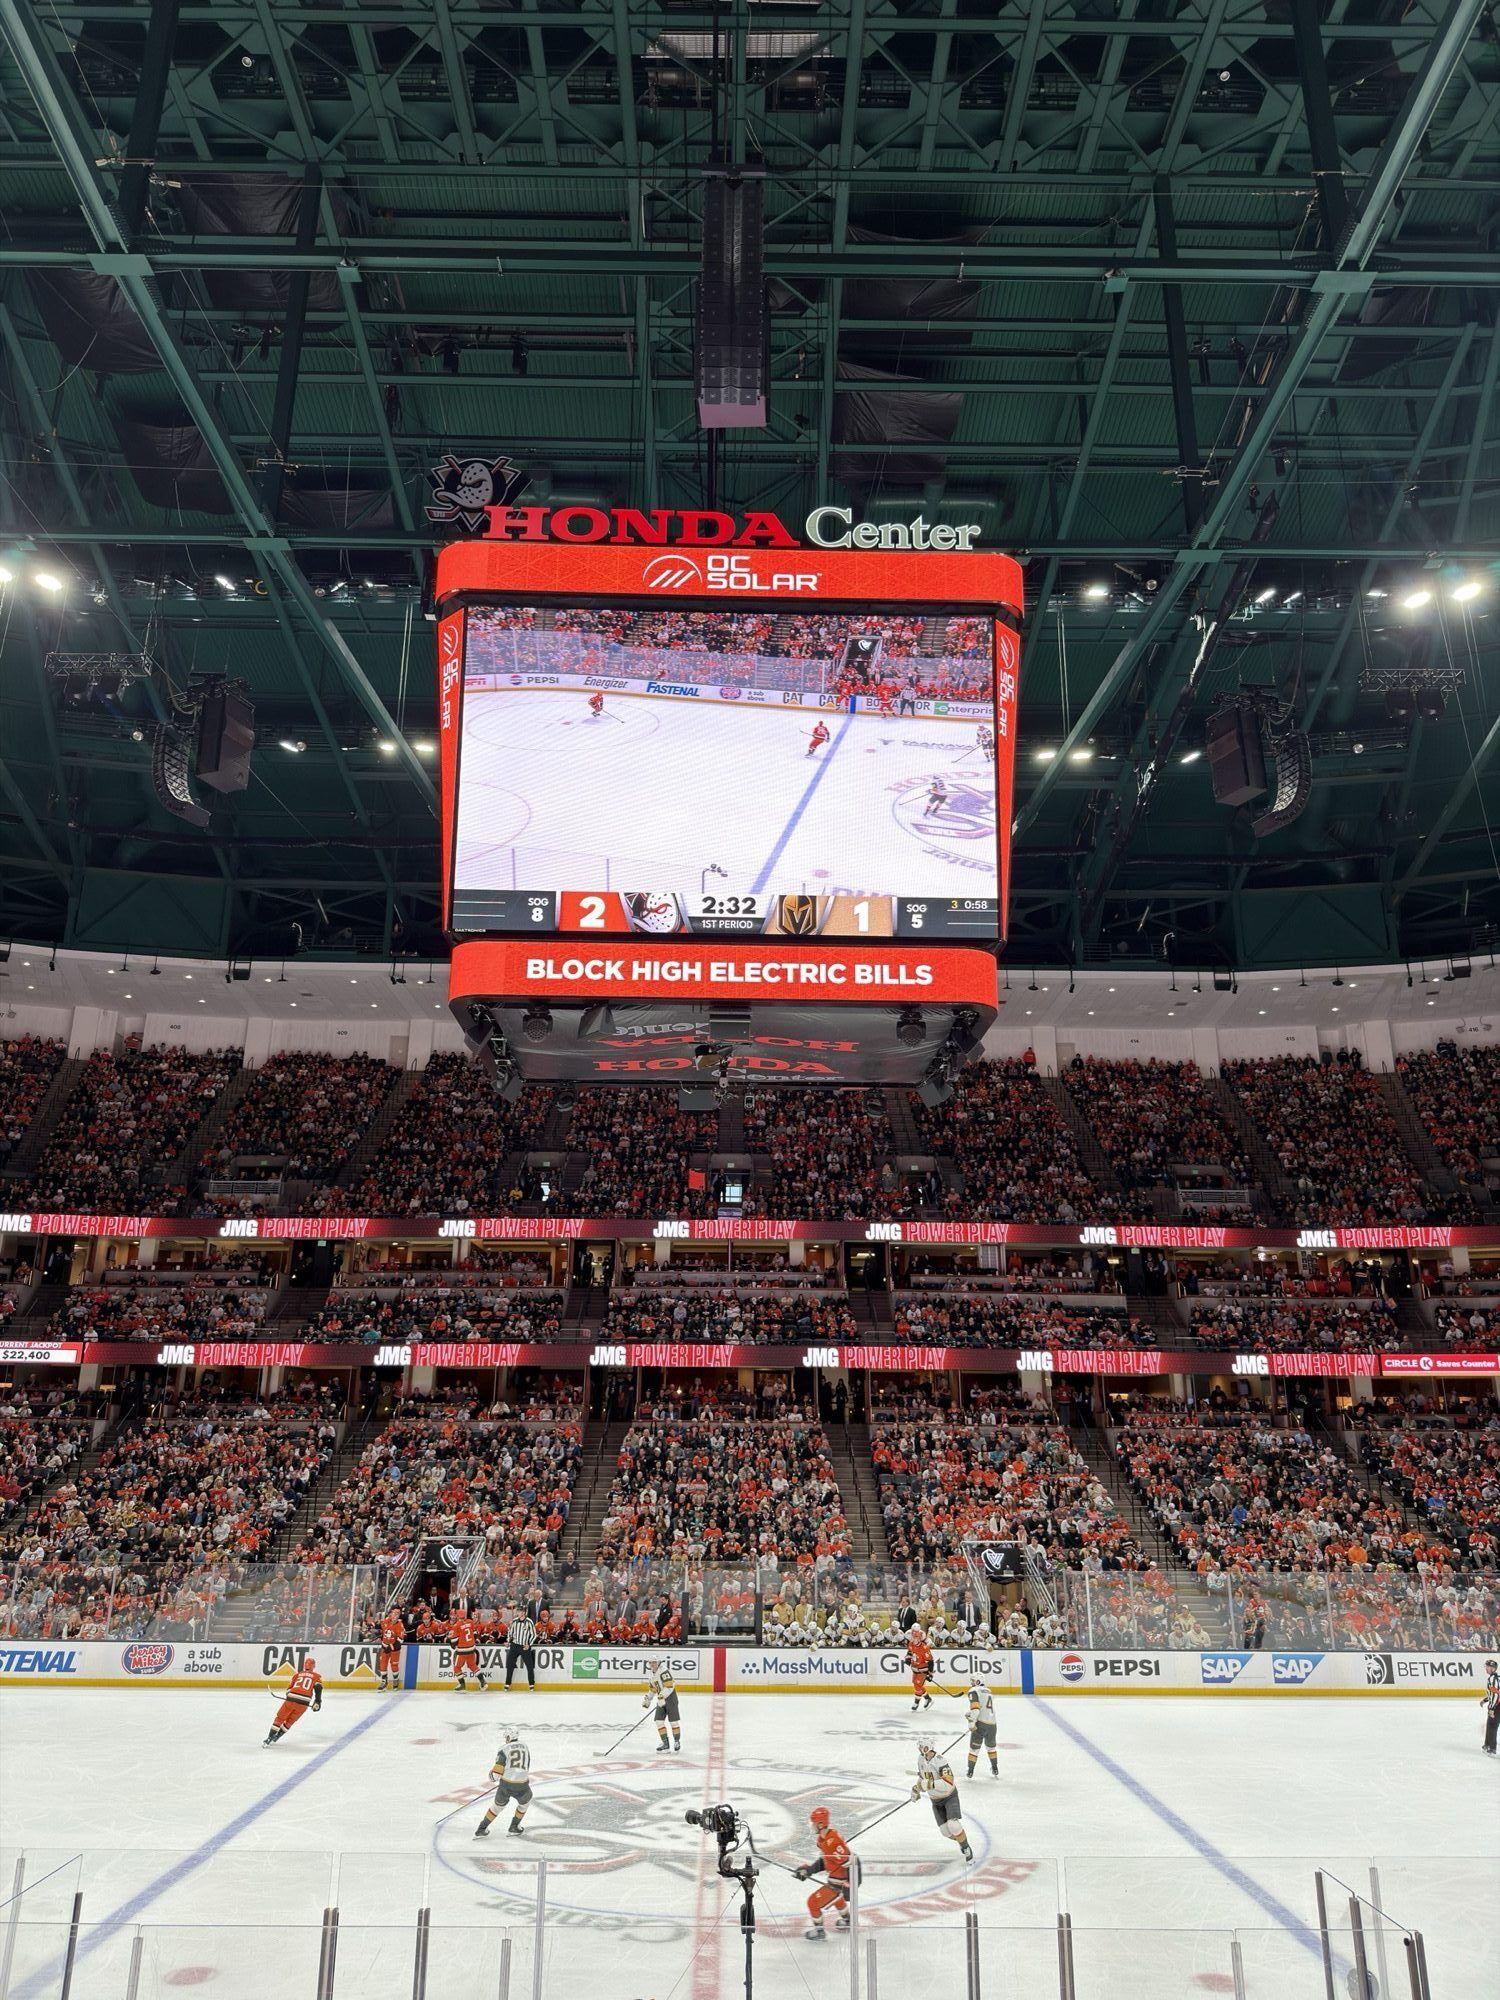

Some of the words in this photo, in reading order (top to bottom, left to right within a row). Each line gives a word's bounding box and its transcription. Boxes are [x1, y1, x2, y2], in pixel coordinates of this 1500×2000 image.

[482, 506, 800, 546] HONDA
[806, 506, 981, 551] Center
[527, 676, 559, 684] PEPSI
[583, 676, 629, 689] Energizer
[646, 681, 700, 697] FASTENAL
[783, 692, 803, 704] CAT
[528, 897, 548, 906] SOG
[702, 896, 757, 915] 2:32
[906, 903, 927, 913] SOG
[951, 901, 958, 909] 3
[964, 900, 988, 910] 0:58
[531, 907, 543, 922] 8
[579, 896, 605, 927] 2
[853, 902, 870, 932] 1
[911, 914, 923, 928] 5
[701, 919, 720, 928] 1ST
[722, 919, 753, 929] PERIOD
[526, 959, 624, 982] BLOCK
[632, 961, 701, 982] HIGH
[710, 962, 847, 984] ELECTRIC
[854, 964, 933, 985] BILLS
[38, 1214, 100, 1235] POWER
[103, 1215, 150, 1237] PLAY
[220, 1219, 259, 1237] JMG
[263, 1218, 326, 1238] POWER
[325, 1218, 369, 1238] PLAY
[438, 1220, 476, 1238] JMG
[480, 1218, 538, 1238] POWER
[542, 1218, 584, 1238] PLAY
[653, 1221, 690, 1238] JMG
[694, 1219, 752, 1239] POWER
[755, 1220, 797, 1240] PLAY
[865, 1223, 904, 1240] JMG
[907, 1222, 964, 1242] POWER
[967, 1223, 1009, 1243] PLAY
[1079, 1227, 1116, 1244] JMG
[1121, 1226, 1178, 1246] POWER
[1183, 1227, 1226, 1247] PLAY
[1297, 1231, 1337, 1248] JMG
[1341, 1228, 1403, 1248] POWER
[1407, 1227, 1452, 1247] PLAY
[2, 1350, 51, 1360] $22,400
[157, 1345, 195, 1365] JMG
[199, 1343, 258, 1365] POWER
[260, 1344, 305, 1365] PLAY
[373, 1347, 411, 1366] JMG
[415, 1344, 474, 1366] POWER
[477, 1344, 521, 1366] PLAY
[589, 1347, 627, 1366] JMG
[631, 1345, 687, 1366] POWER
[690, 1345, 734, 1367] PLAY
[802, 1348, 840, 1368] JMG
[844, 1347, 902, 1368] POWER
[905, 1348, 947, 1370] PLAY
[1016, 1351, 1053, 1371] JMG
[1057, 1351, 1116, 1373] POWER
[1119, 1352, 1161, 1374] PLAY
[1231, 1355, 1269, 1374] JMG
[1272, 1354, 1332, 1376] POWER
[1334, 1354, 1378, 1376] PLAY
[1436, 1360, 1461, 1368] Saves
[1462, 1360, 1496, 1368] Counter
[464, 1628, 471, 1641] 2
[130, 1644, 166, 1658] Jersey
[188, 1649, 195, 1659] a
[200, 1647, 221, 1659] sub
[184, 1661, 222, 1673] above
[262, 1645, 310, 1677] CAT
[763, 1657, 868, 1674] MassMutual
[1060, 1664, 1084, 1672] PEPSI
[1094, 1658, 1160, 1676] PEPSI
[1202, 1659, 1242, 1678] SAP
[1273, 1659, 1313, 1678] SAP
[1397, 1662, 1474, 1677] BETMGM
[293, 1676, 312, 1690] 20
[509, 1749, 528, 1769] 21
